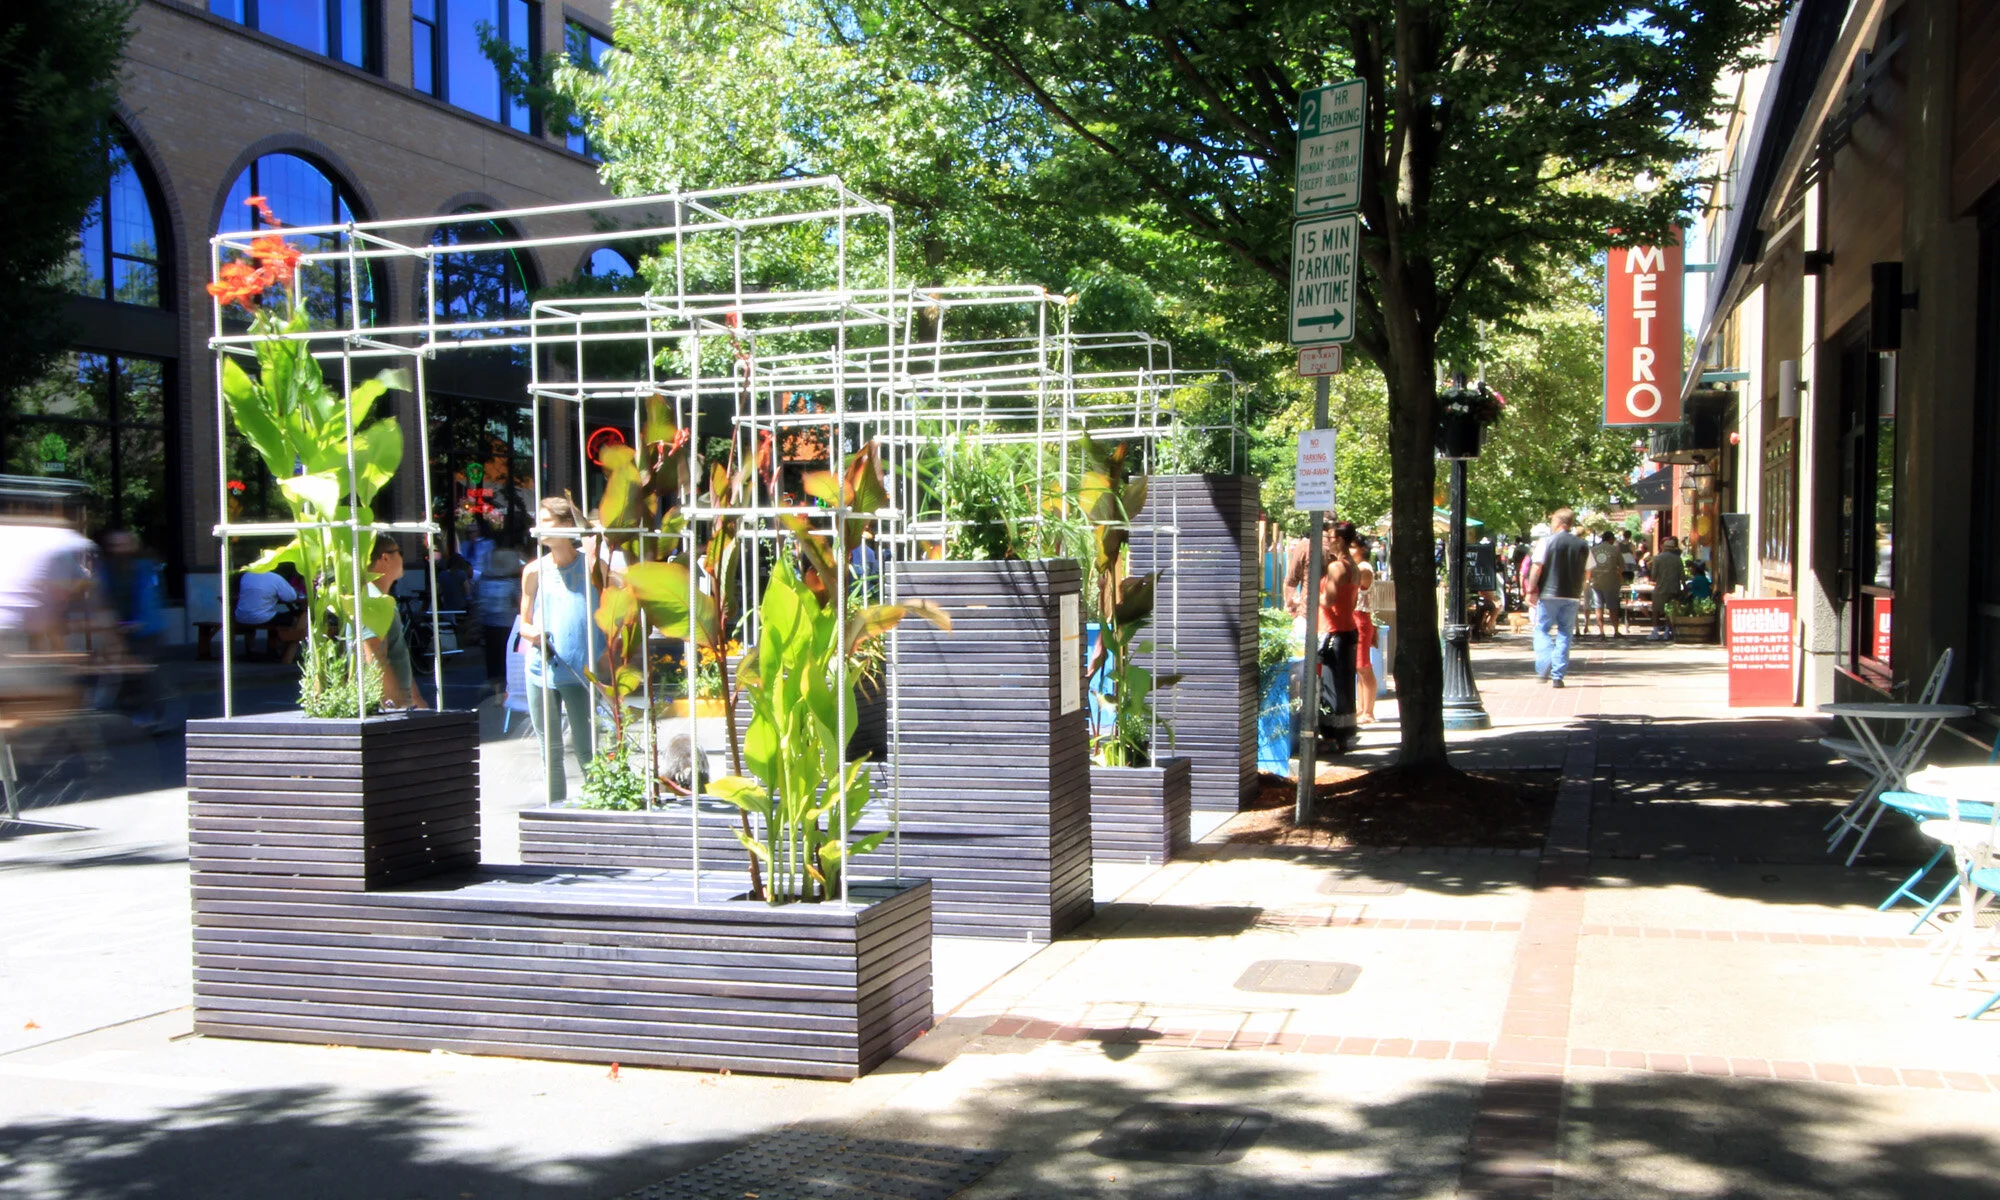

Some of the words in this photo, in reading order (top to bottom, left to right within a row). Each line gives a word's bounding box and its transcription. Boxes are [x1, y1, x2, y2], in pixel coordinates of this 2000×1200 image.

[1334, 89, 1349, 106] HR
[1303, 99, 1317, 131] 2
[1321, 107, 1360, 129] PARKING
[1309, 144, 1325, 158] 7AM
[1335, 139, 1350, 153] 6PM
[1299, 176, 1323, 192] EXCEPT
[1325, 170, 1357, 187] HOLIDAYS
[1301, 230, 1317, 255] 15
[1322, 225, 1350, 252] MIN
[1297, 252, 1351, 282] PARKING
[1296, 279, 1349, 308] ANYTIME
[1624, 244, 1666, 418] METRO
[1303, 352, 1336, 361] TOW-AWAY
[1311, 362, 1328, 370] ZONE
[1310, 438, 1319, 447] NO
[1303, 452, 1327, 462] PARKING
[1731, 644, 1790, 653] NIGHTLIFE
[1731, 654, 1790, 662] CLASSIFIEDS
